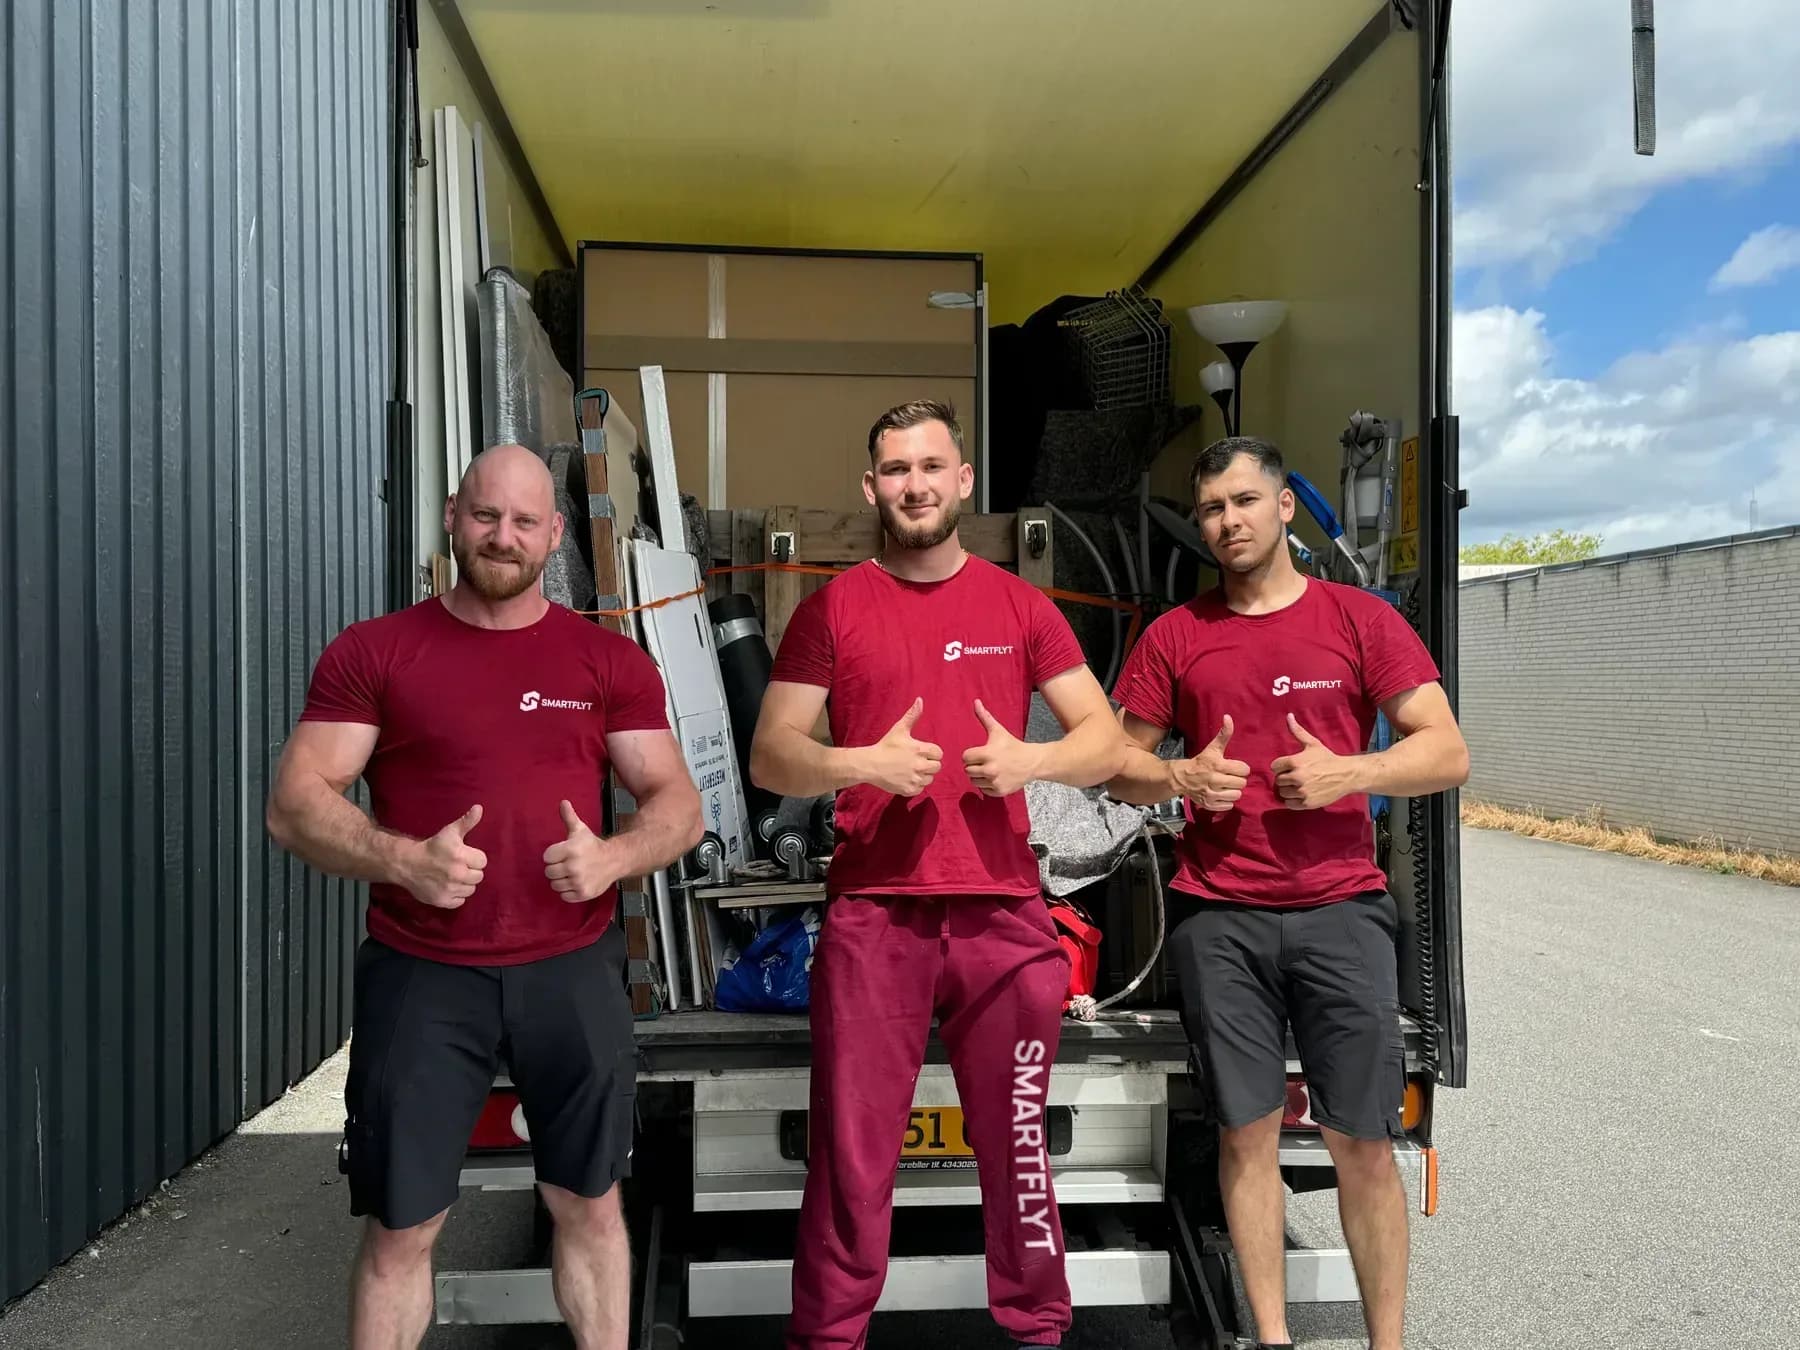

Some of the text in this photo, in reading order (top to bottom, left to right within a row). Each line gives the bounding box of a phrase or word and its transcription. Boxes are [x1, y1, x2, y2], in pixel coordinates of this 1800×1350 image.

[963, 646, 1014, 655] SMARTFLYT
[1292, 680, 1342, 690] SMARTFLYT
[541, 698, 593, 710] SMARTFLYT
[1012, 1039, 1057, 1256] SMARTFLYT
